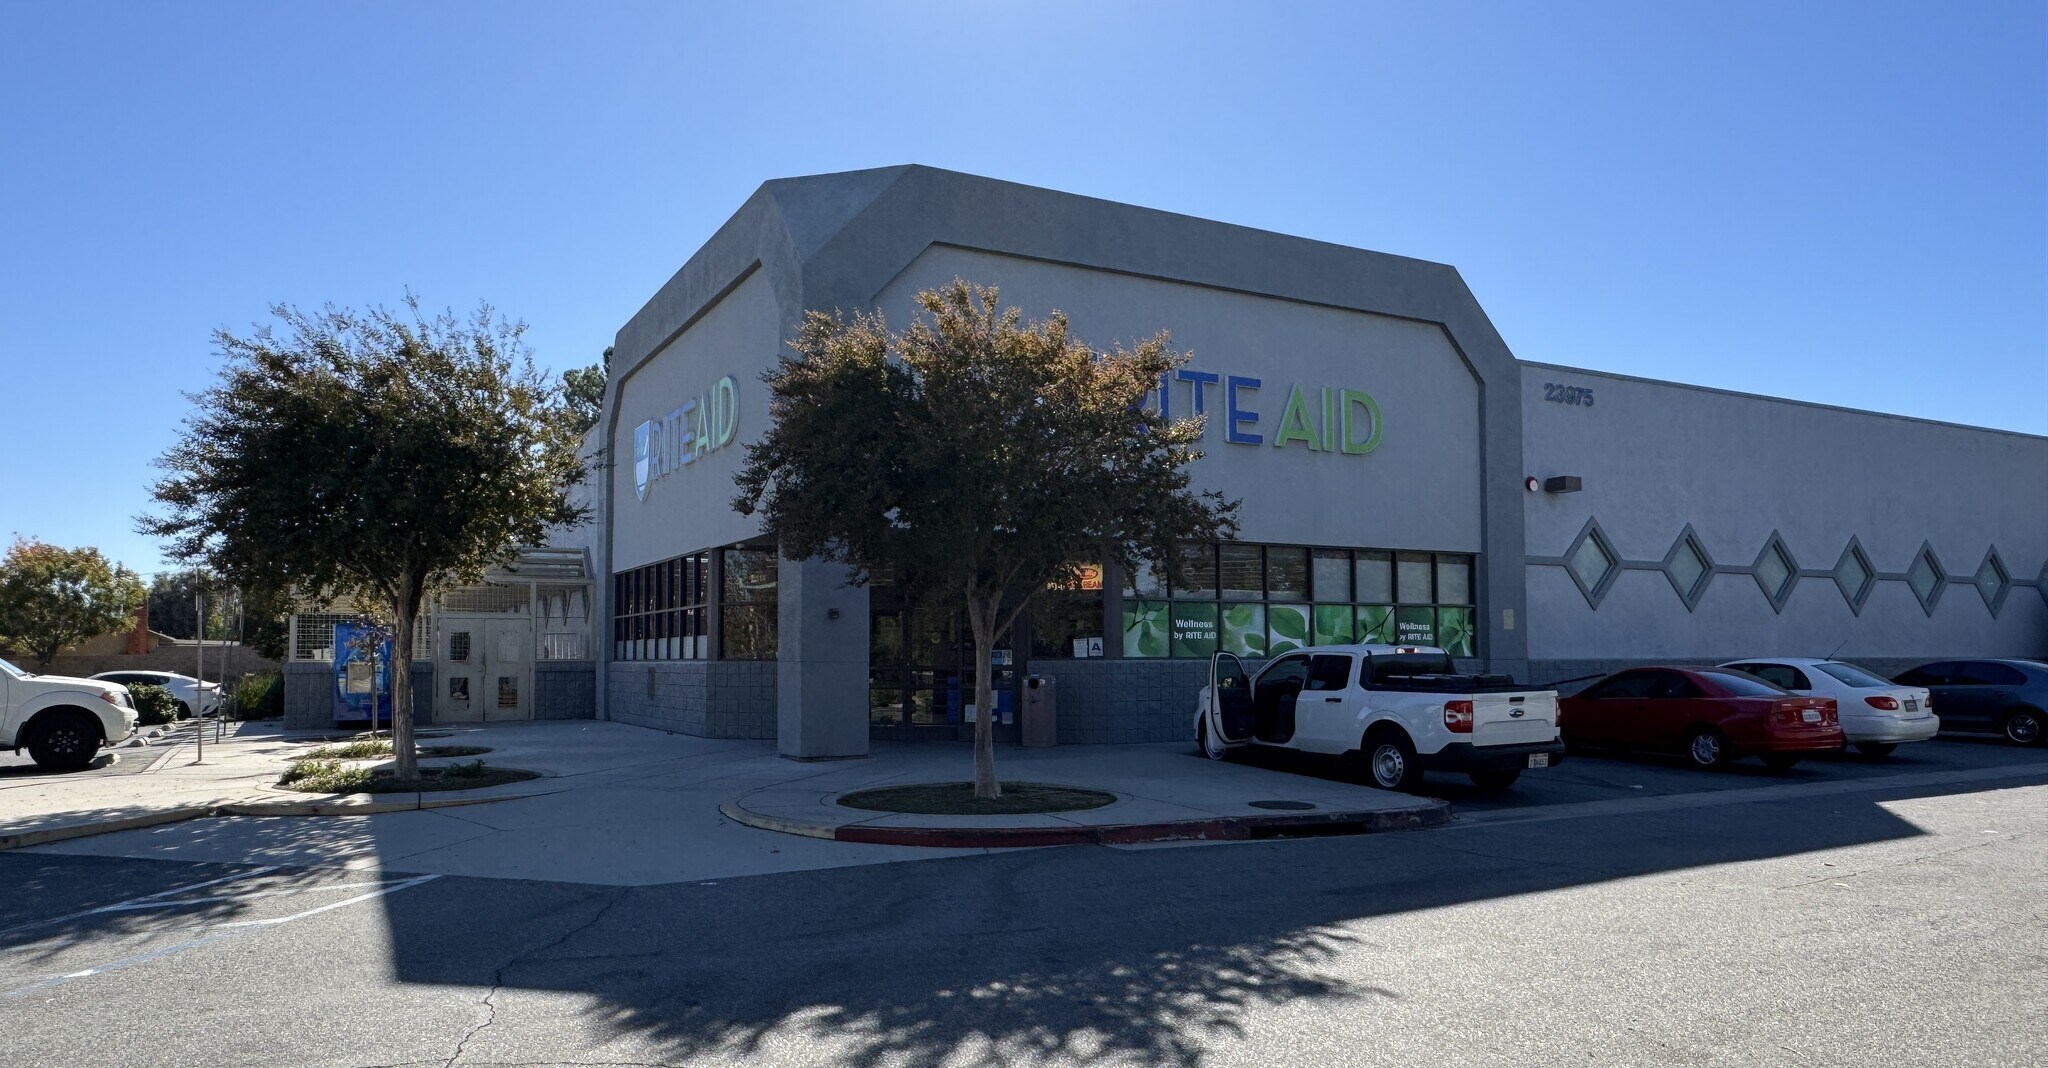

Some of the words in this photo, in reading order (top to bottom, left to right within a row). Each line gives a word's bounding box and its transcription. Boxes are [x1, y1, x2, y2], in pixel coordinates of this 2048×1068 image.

[1544, 382, 1594, 407] 23975
[1273, 383, 1384, 455] AID
[650, 398, 695, 480] RITE
[695, 375, 740, 458] AID
[1175, 619, 1213, 628] Wellness
[1399, 622, 1430, 630] Wellness
[1173, 631, 1184, 640] by
[1185, 631, 1202, 639] RITE
[1203, 631, 1217, 639] AID
[1091, 642, 1101, 651] A
